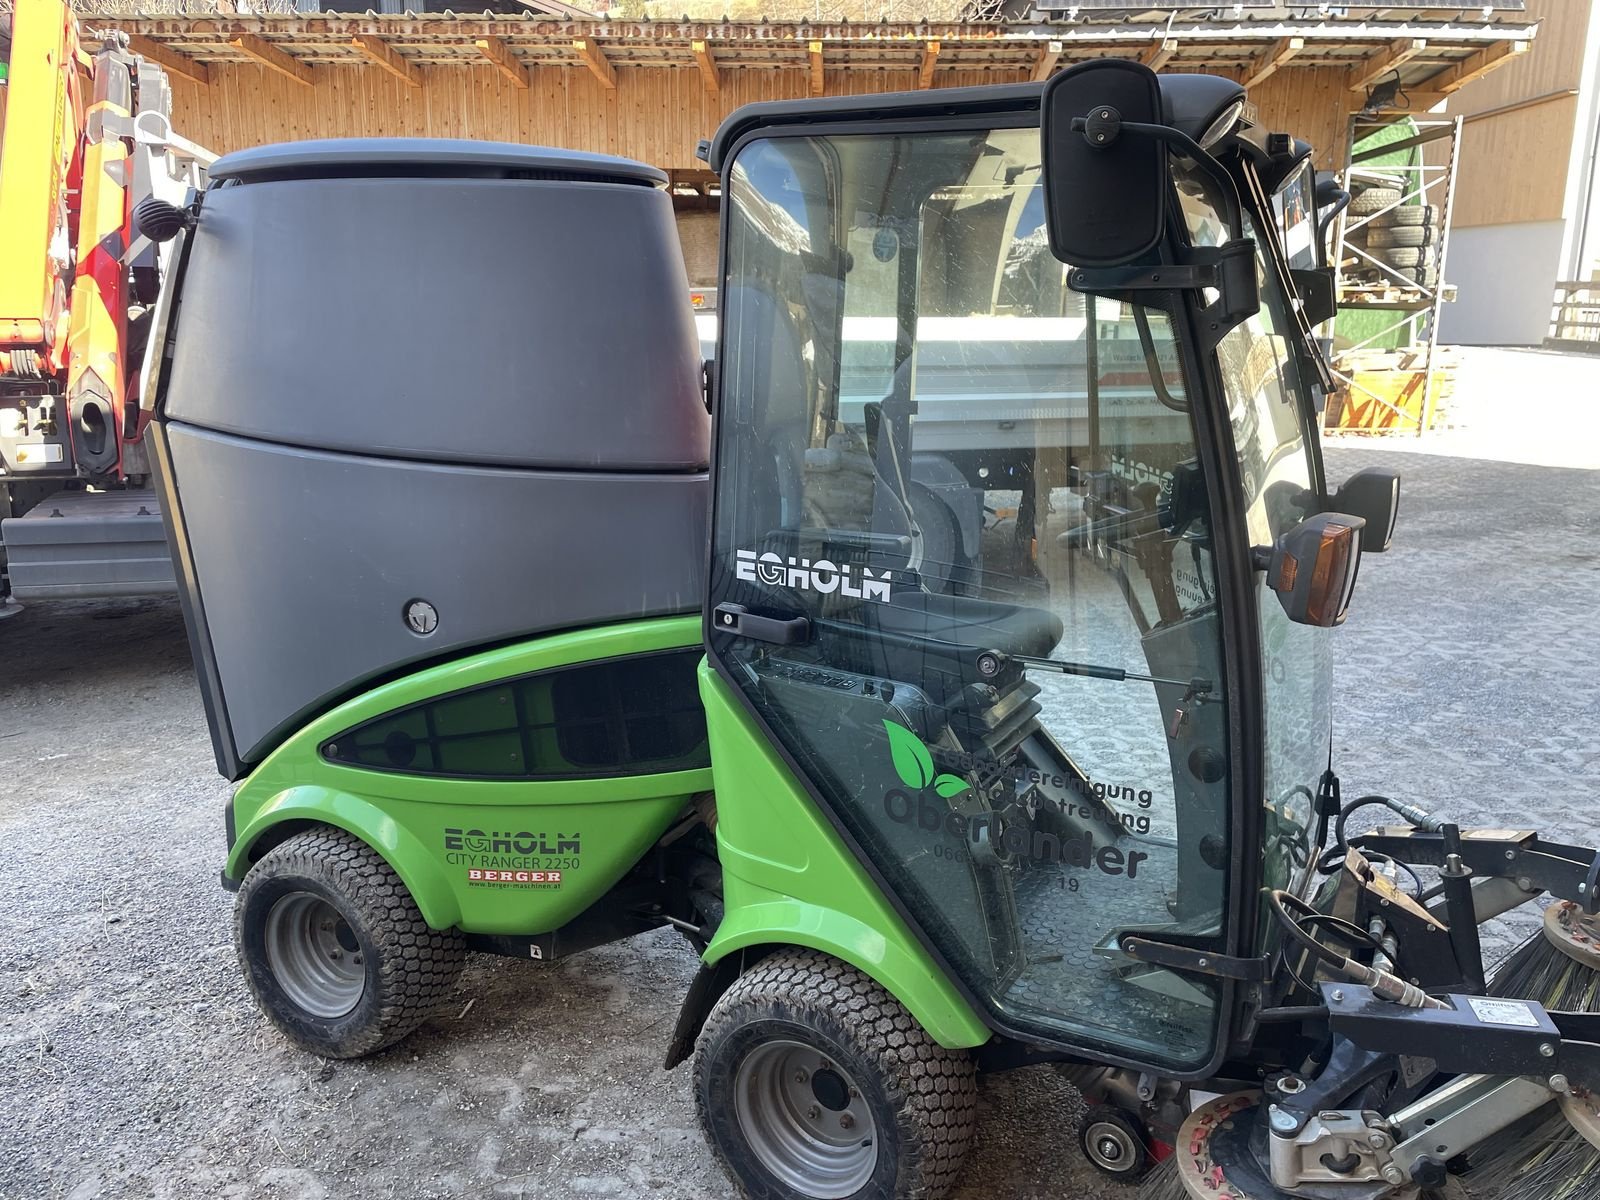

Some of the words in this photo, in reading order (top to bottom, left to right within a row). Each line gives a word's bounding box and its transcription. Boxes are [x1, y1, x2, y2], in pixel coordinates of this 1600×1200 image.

[736, 549, 892, 603] EGHOLM
[445, 828, 580, 855] EGHOLM
[446, 853, 477, 866] CITY
[481, 855, 541, 869] RANGER
[544, 858, 580, 870] 2250
[469, 869, 561, 882] BERGER
[469, 881, 561, 890] www.berger-maschinen.at
